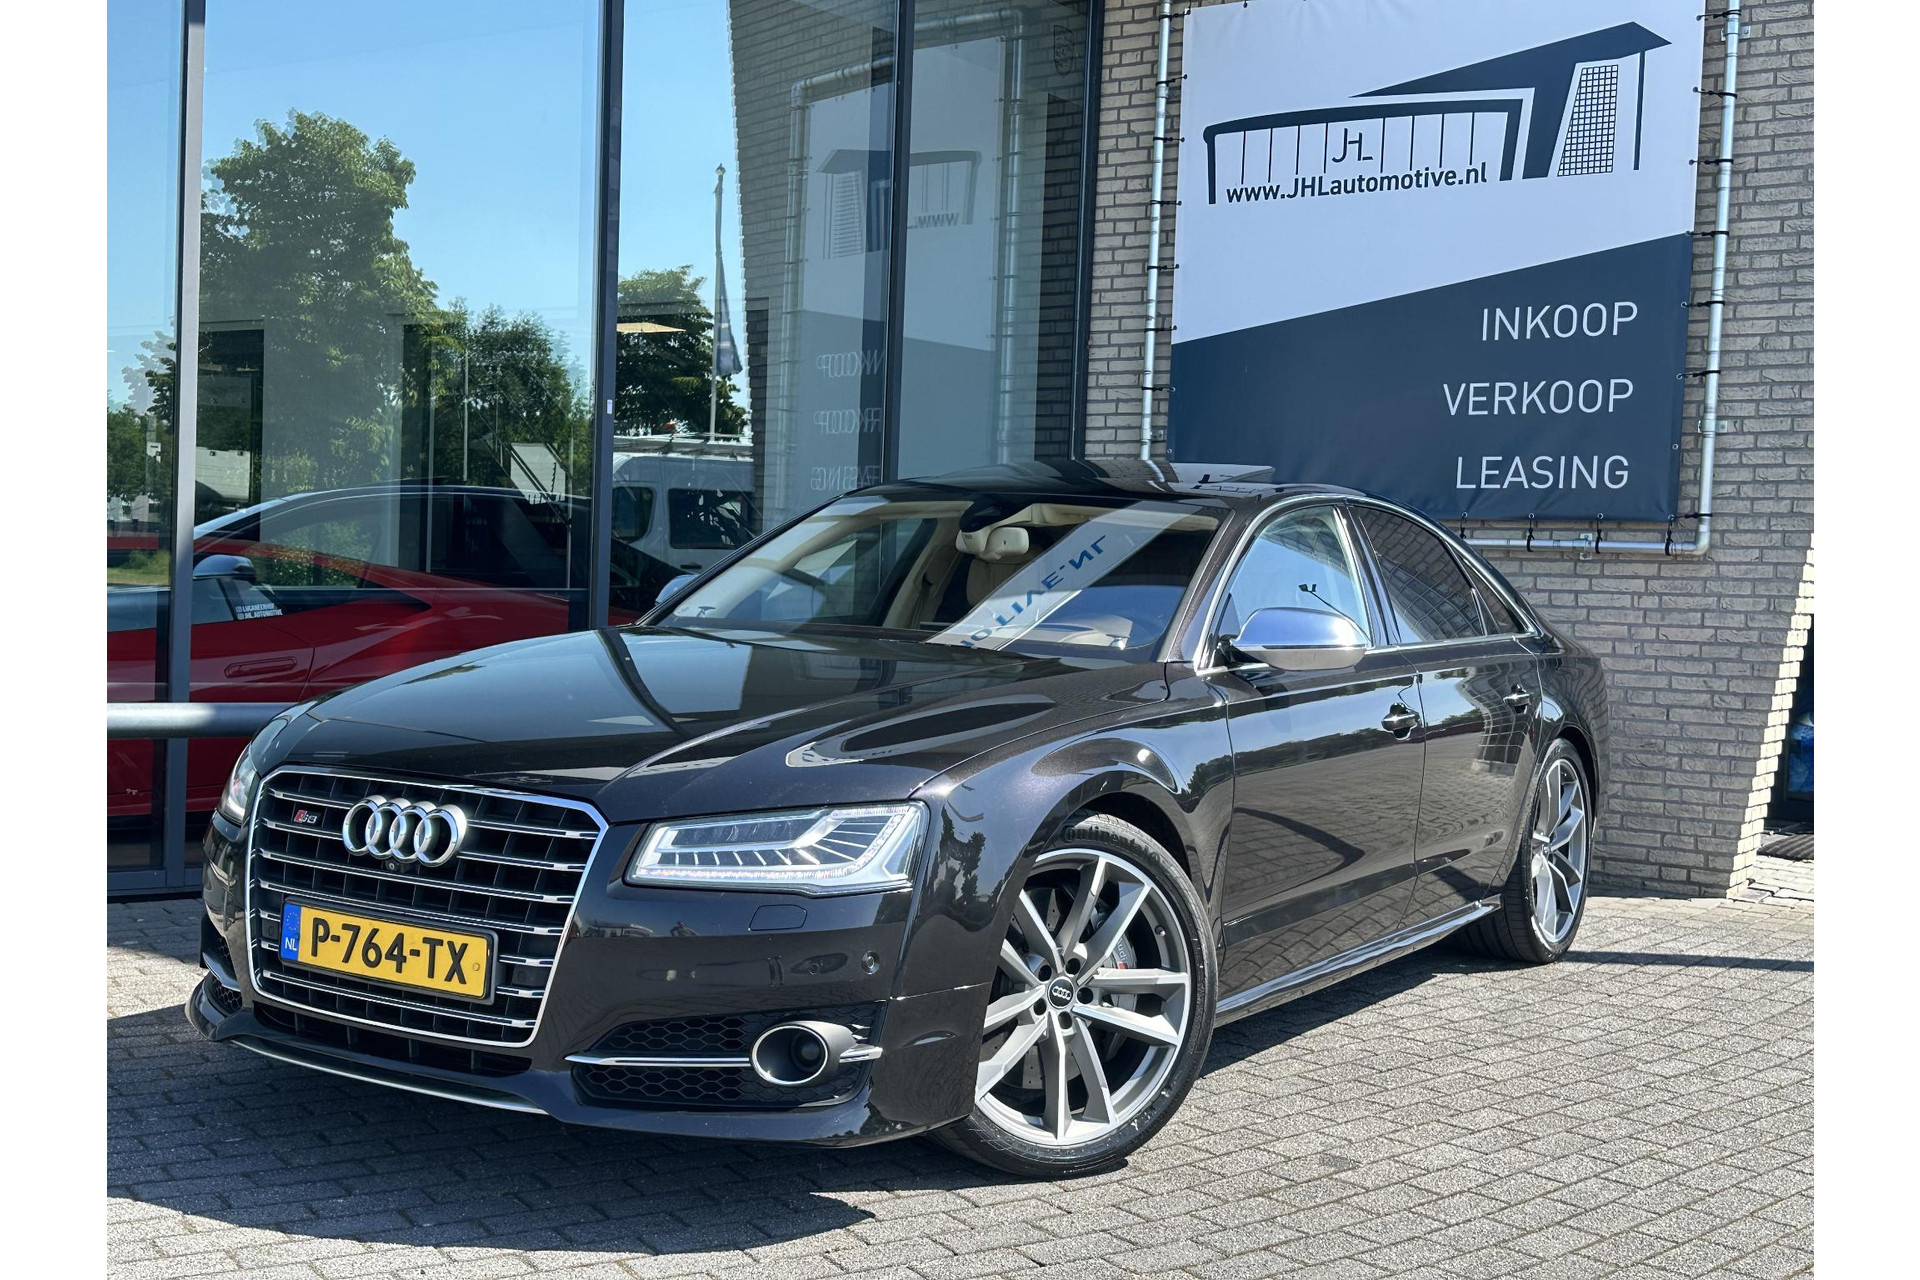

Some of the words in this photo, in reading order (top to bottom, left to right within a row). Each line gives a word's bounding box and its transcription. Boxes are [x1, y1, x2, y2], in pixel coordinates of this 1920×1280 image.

[1332, 128, 1373, 163] JHL
[1226, 162, 1487, 203] www.JHLautomotive.nl
[1482, 302, 1637, 341] INKOOP
[1444, 379, 1633, 416] VERKOOP
[1456, 455, 1629, 489] LEASING
[285, 936, 298, 951] NL
[311, 917, 467, 985] P-764-TX
